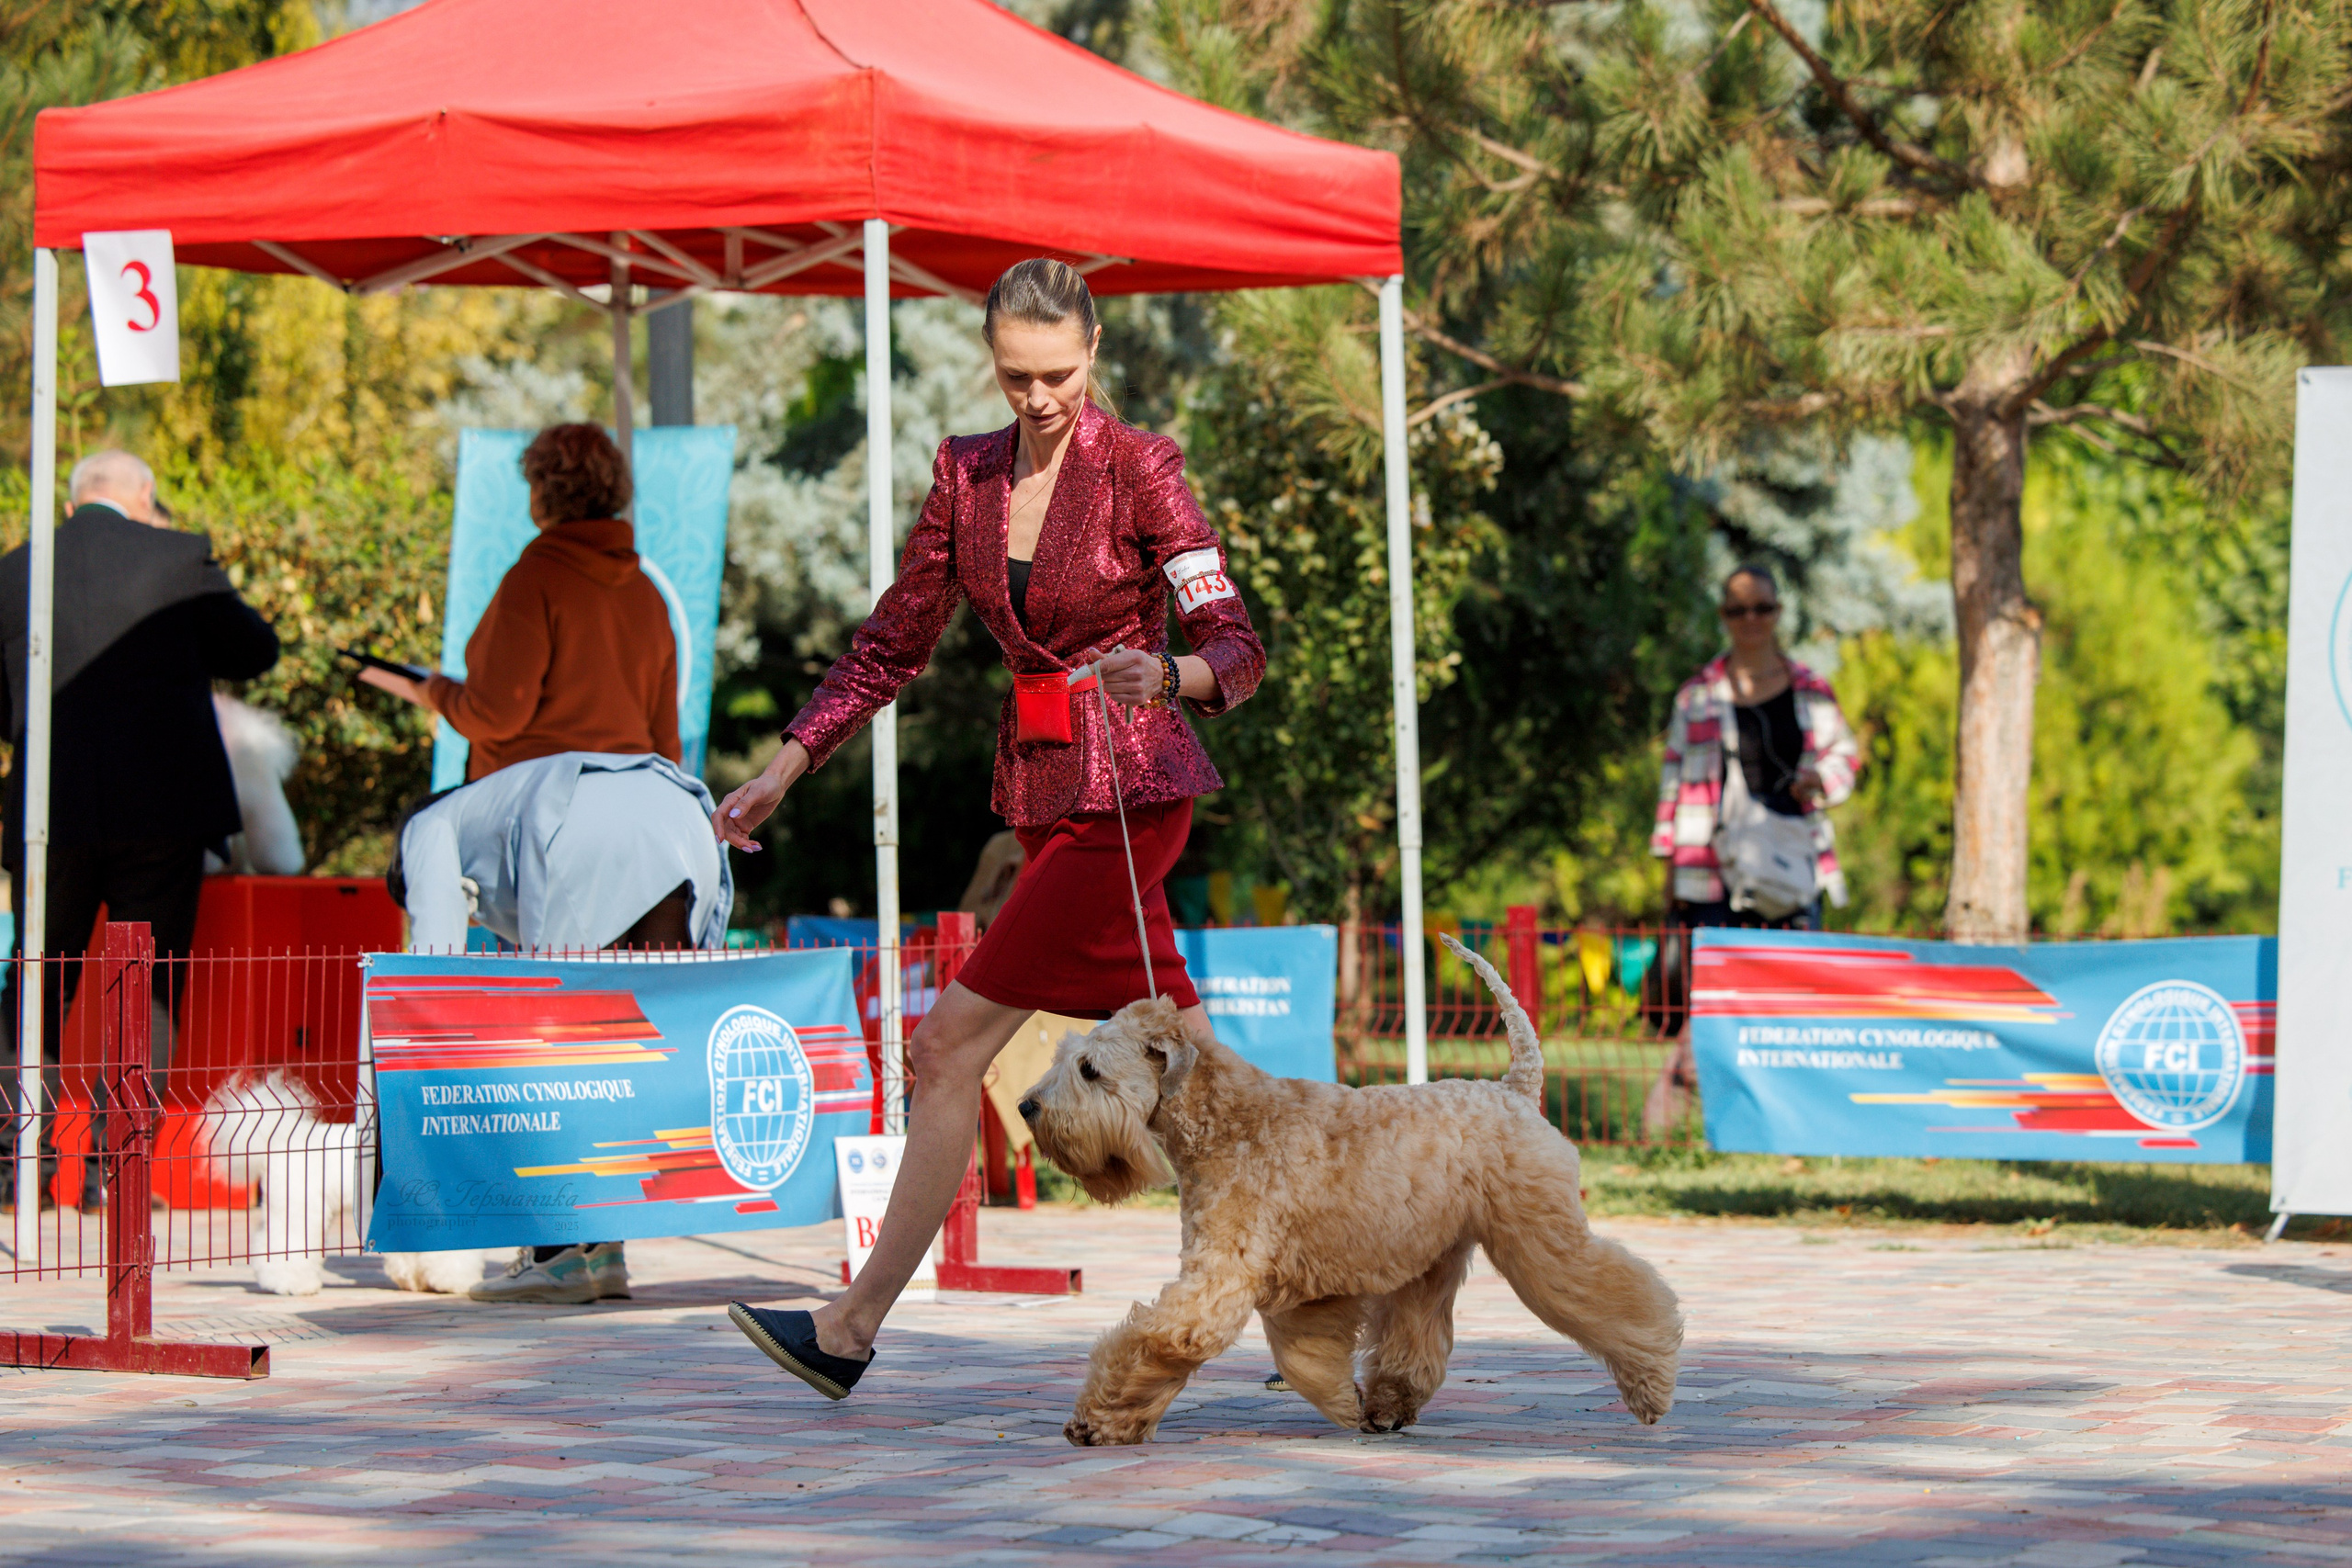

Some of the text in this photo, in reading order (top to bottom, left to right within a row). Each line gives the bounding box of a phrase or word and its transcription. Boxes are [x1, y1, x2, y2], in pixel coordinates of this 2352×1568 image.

[120, 260, 161, 333] 3
[1181, 570, 1227, 603] 143
[1737, 1026, 2002, 1051] FEDERATION CYNOLOGIQUE
[1736, 1048, 1905, 1070] INTERNATIONALE
[2143, 1042, 2199, 1072] FCI
[421, 1078, 636, 1105] FEDERATION CYNOLOGIQUE
[714, 1014, 809, 1179] FEDERATION CYNOLOGIQUE INTERNATIONALE
[742, 1078, 784, 1113] FCI
[420, 1111, 561, 1135] INTERNATIONALE
